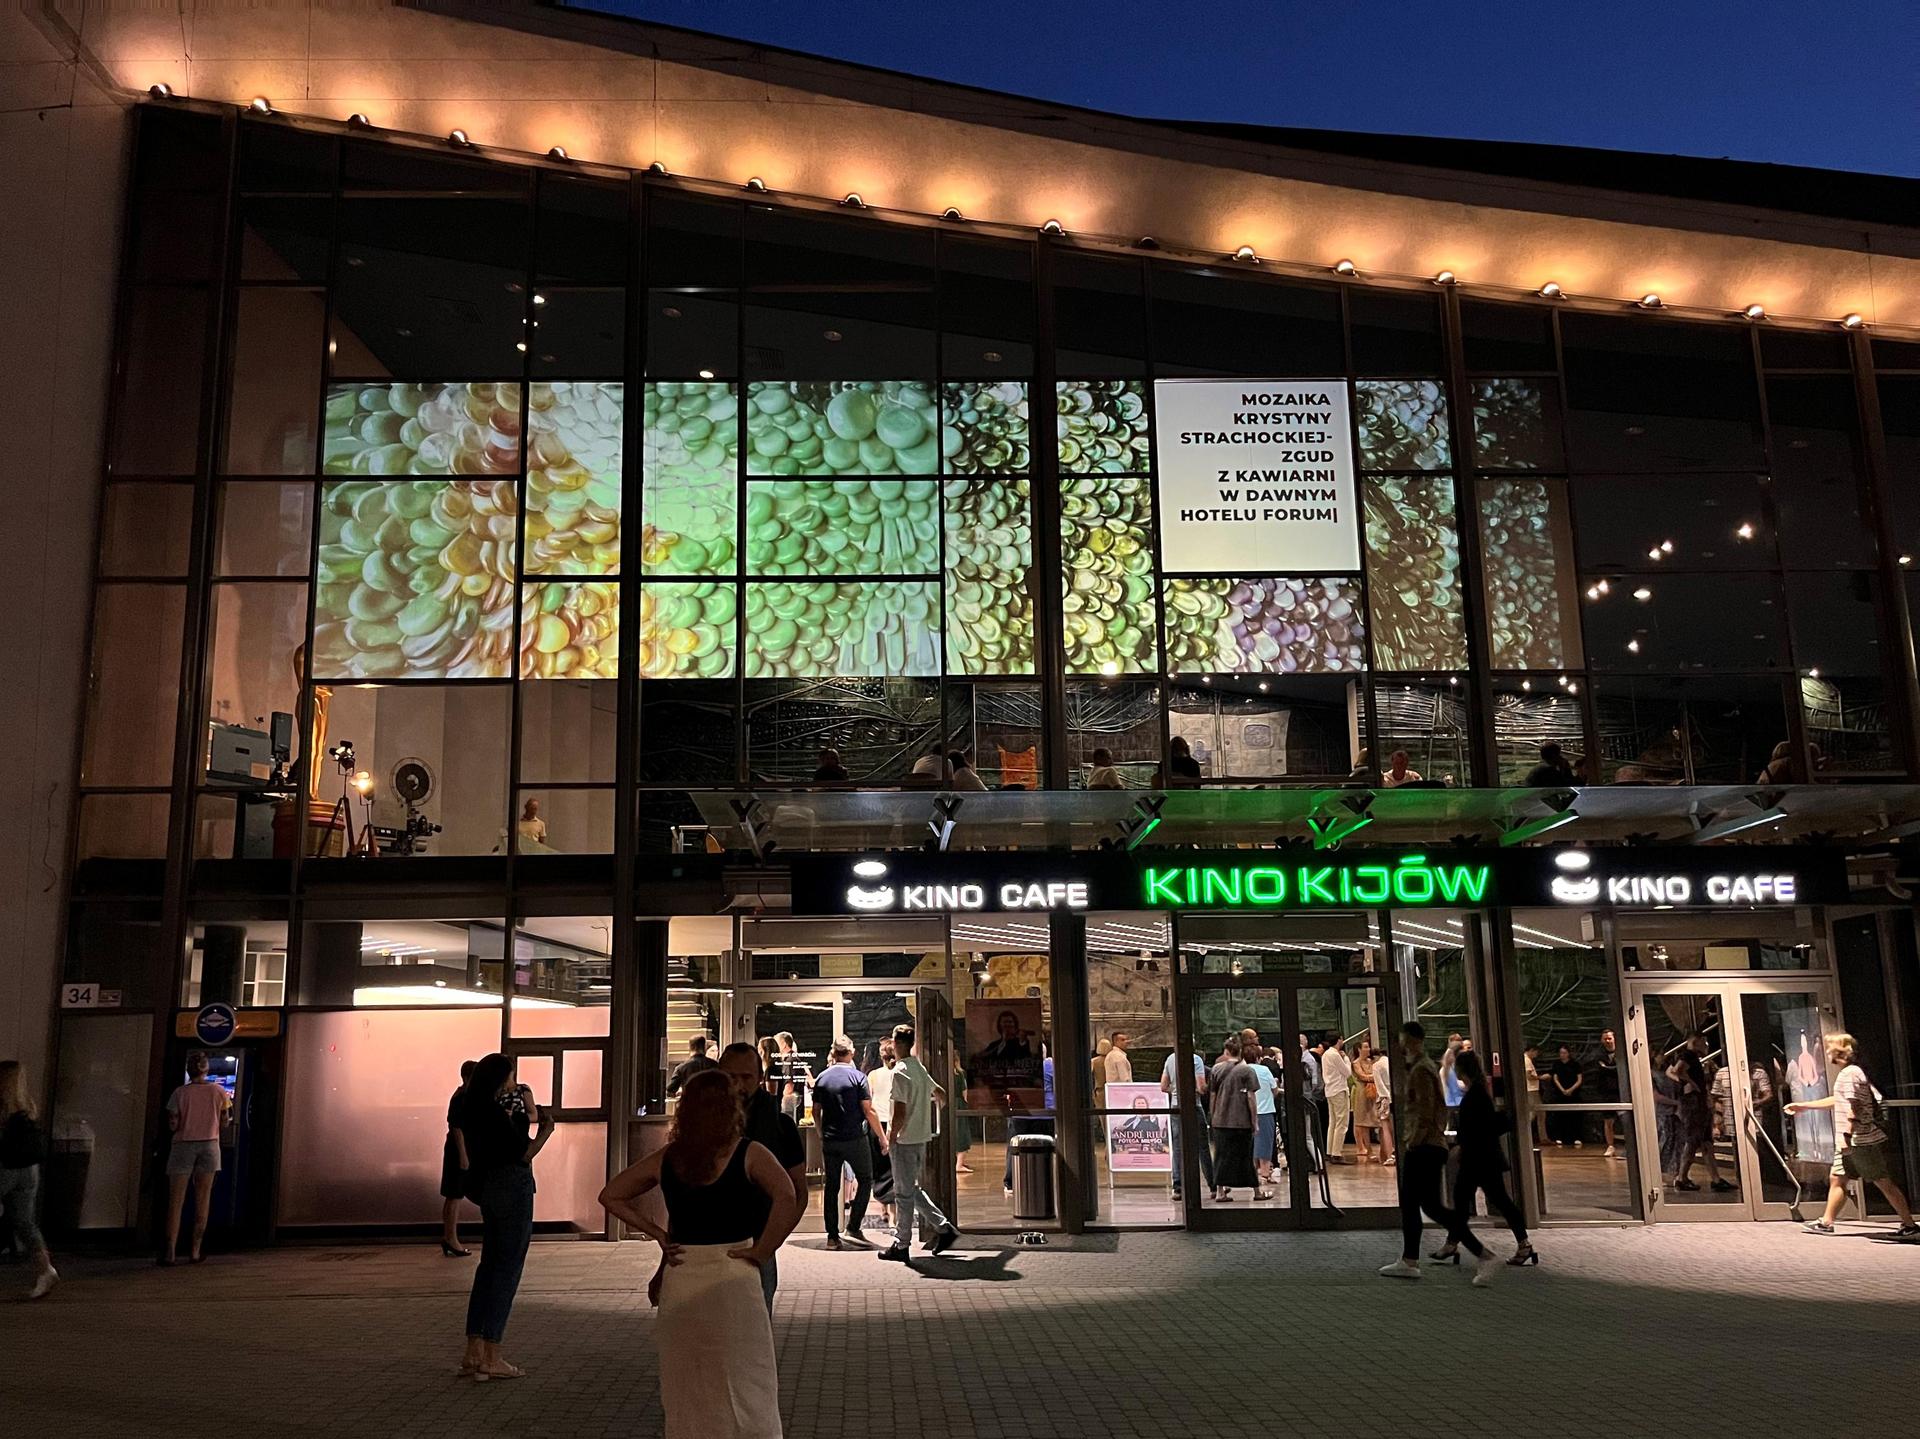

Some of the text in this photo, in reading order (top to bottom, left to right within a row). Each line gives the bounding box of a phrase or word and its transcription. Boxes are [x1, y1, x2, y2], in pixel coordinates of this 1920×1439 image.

[1241, 393, 1331, 406] MOZAIKA
[1233, 412, 1332, 425] KRYSTYNY
[1180, 431, 1333, 444] STRACHOCKIEJ-
[1281, 450, 1334, 463] ZGUD
[1218, 470, 1335, 482] Z KAWIARNI
[1219, 489, 1336, 502] W DAWNYM
[1180, 509, 1256, 521] HOTELU
[1145, 855, 1489, 904] KINO KIJÓW
[1608, 875, 1795, 902] KINO CAFE
[903, 883, 1089, 909] KINO CAFE
[68, 988, 91, 1003] 34
